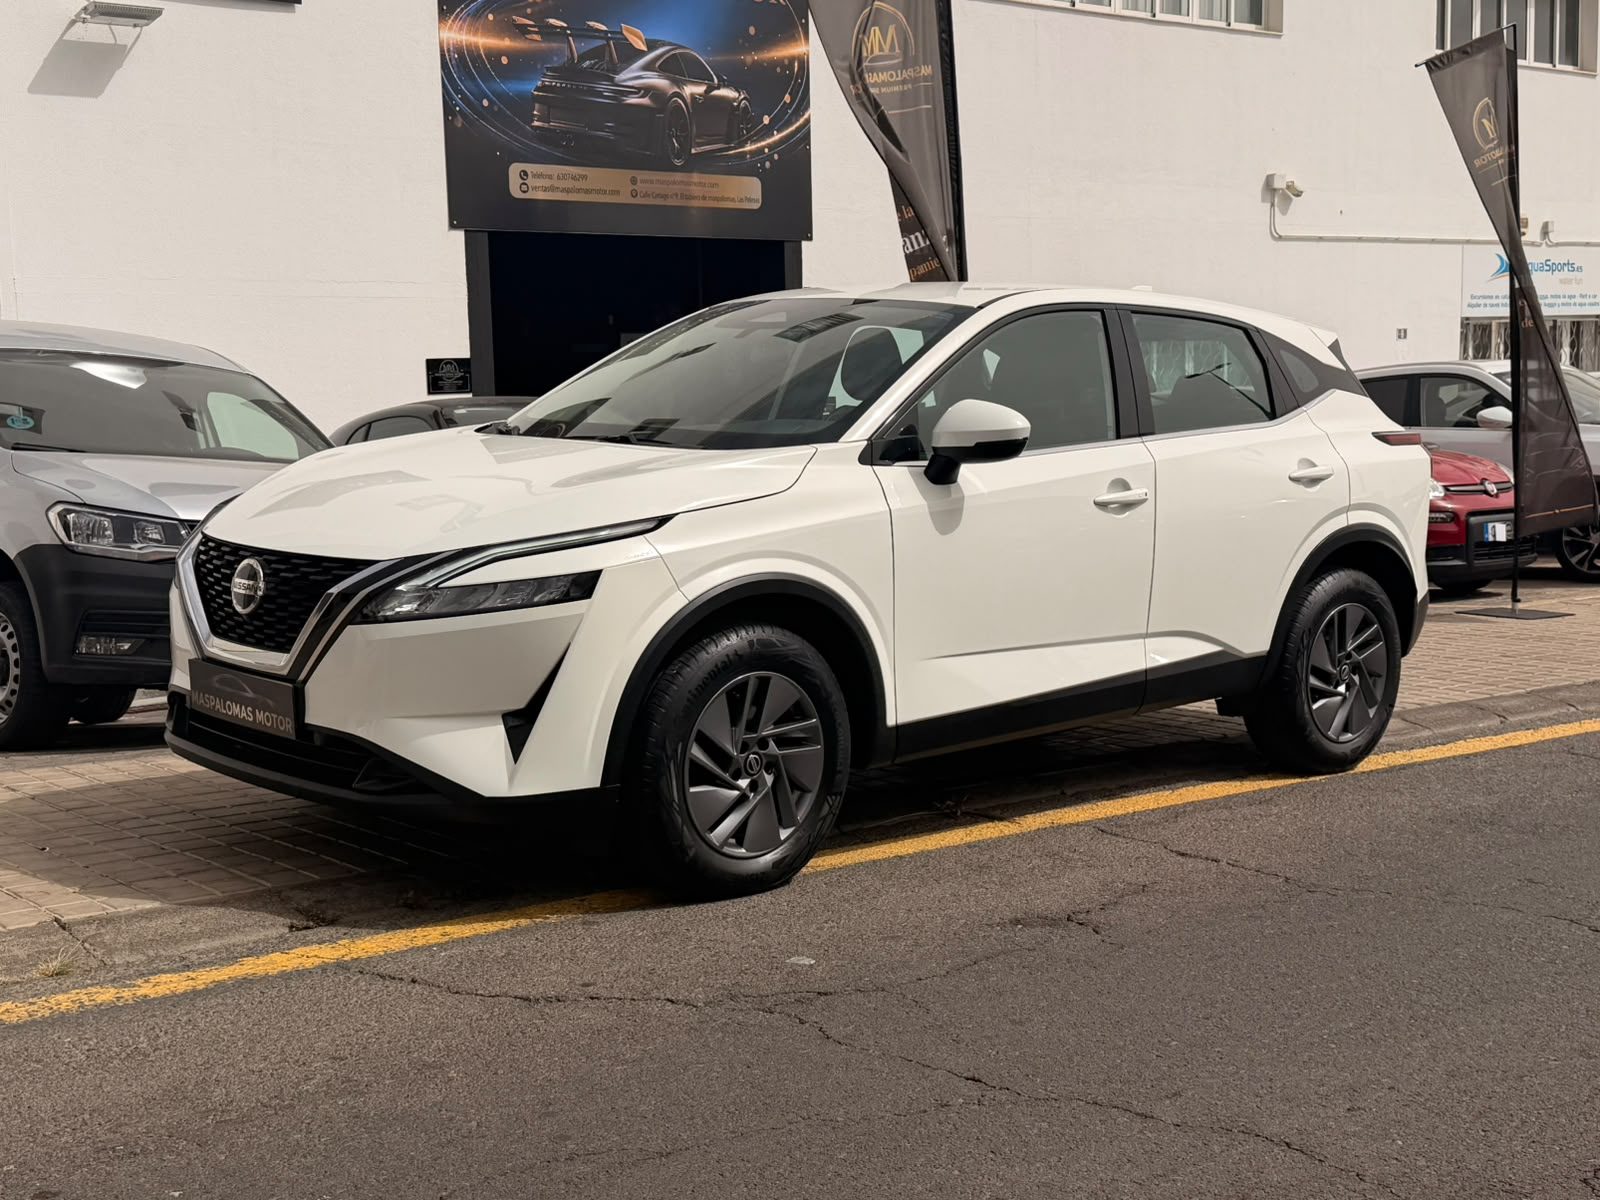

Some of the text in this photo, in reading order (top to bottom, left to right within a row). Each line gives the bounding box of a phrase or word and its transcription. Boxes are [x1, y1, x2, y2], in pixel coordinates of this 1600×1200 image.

[1528, 258, 1584, 276] quaSports.es
[191, 689, 293, 735] MASPALOMAS MOTOR
